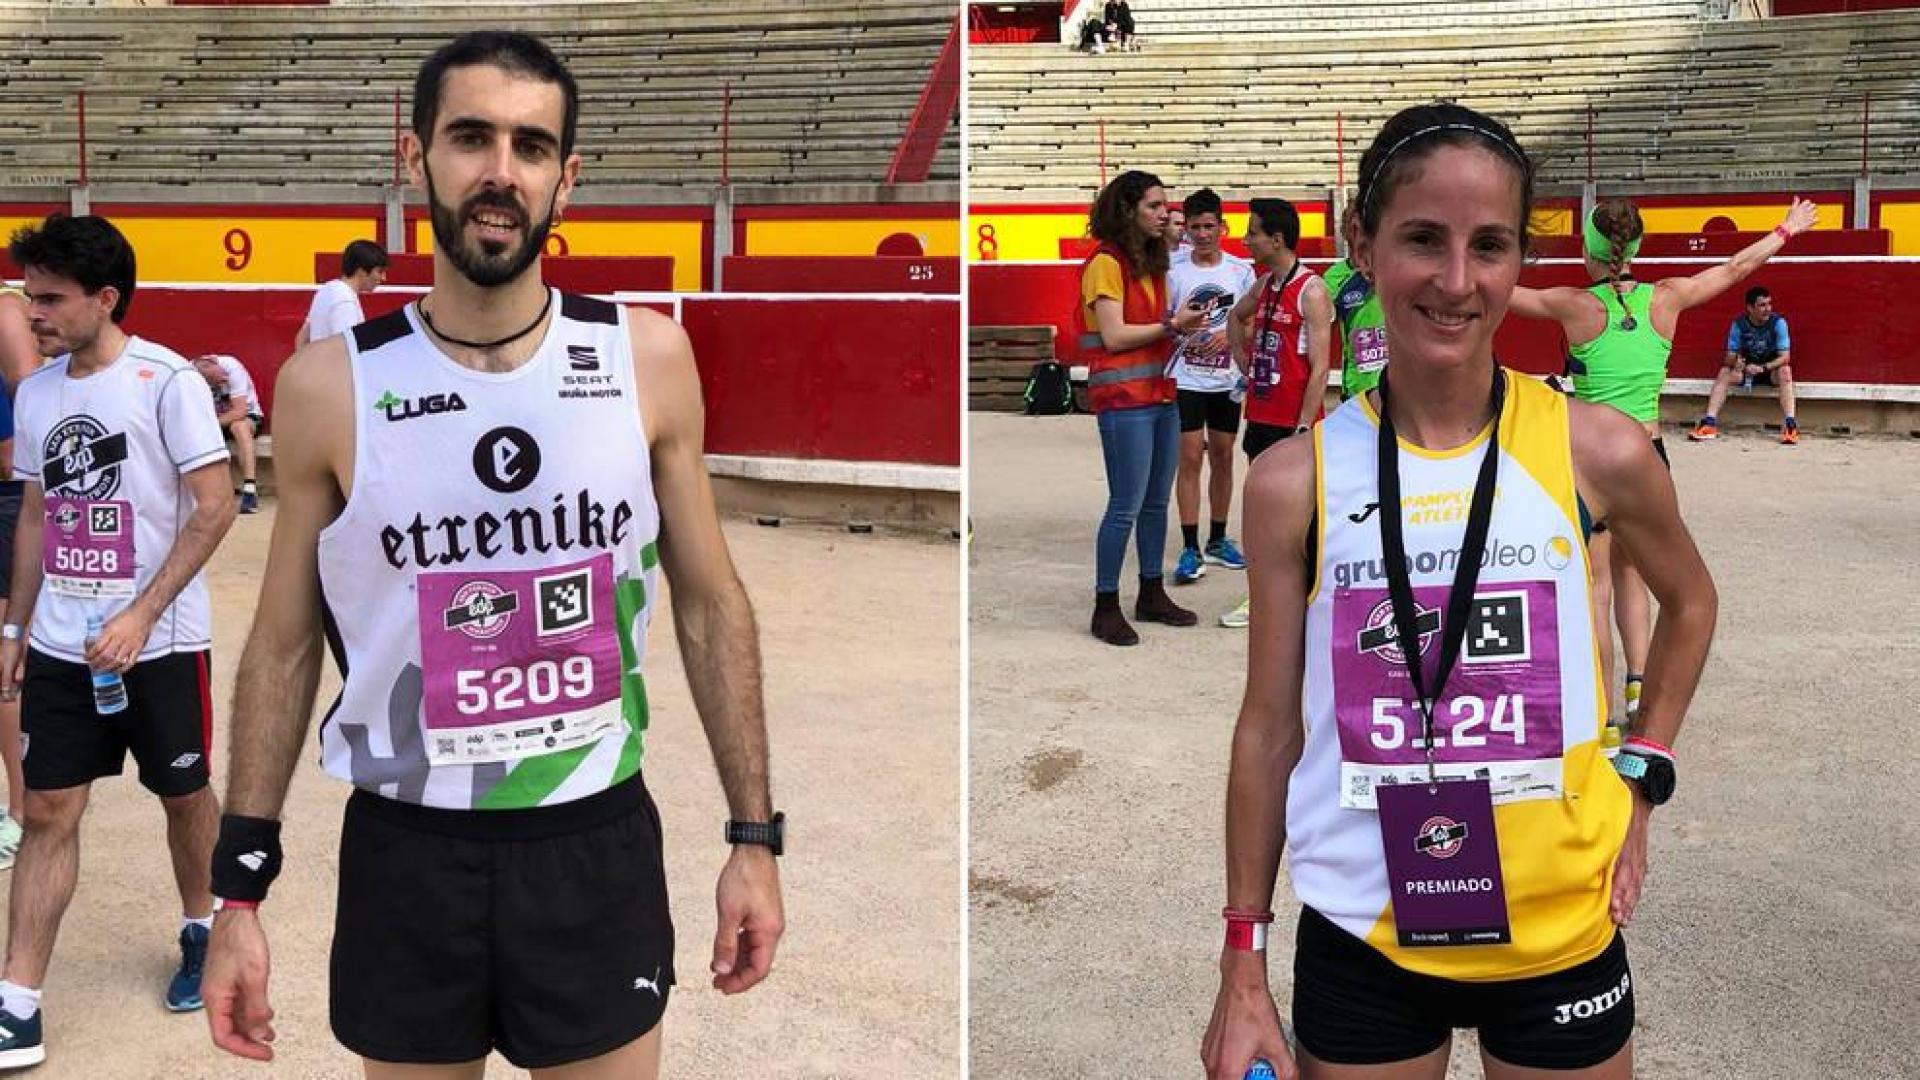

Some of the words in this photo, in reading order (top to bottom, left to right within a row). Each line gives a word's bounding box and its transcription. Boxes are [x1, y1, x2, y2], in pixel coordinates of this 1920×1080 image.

[223, 228, 252, 271] 9
[563, 374, 613, 384] SEAT
[386, 392, 467, 422] LUGA
[381, 489, 633, 570] etxenike
[56, 546, 118, 573] 5028
[456, 656, 594, 715] 5209
[1371, 693, 1526, 750] 5124
[1405, 877, 1493, 895] PREMIADO
